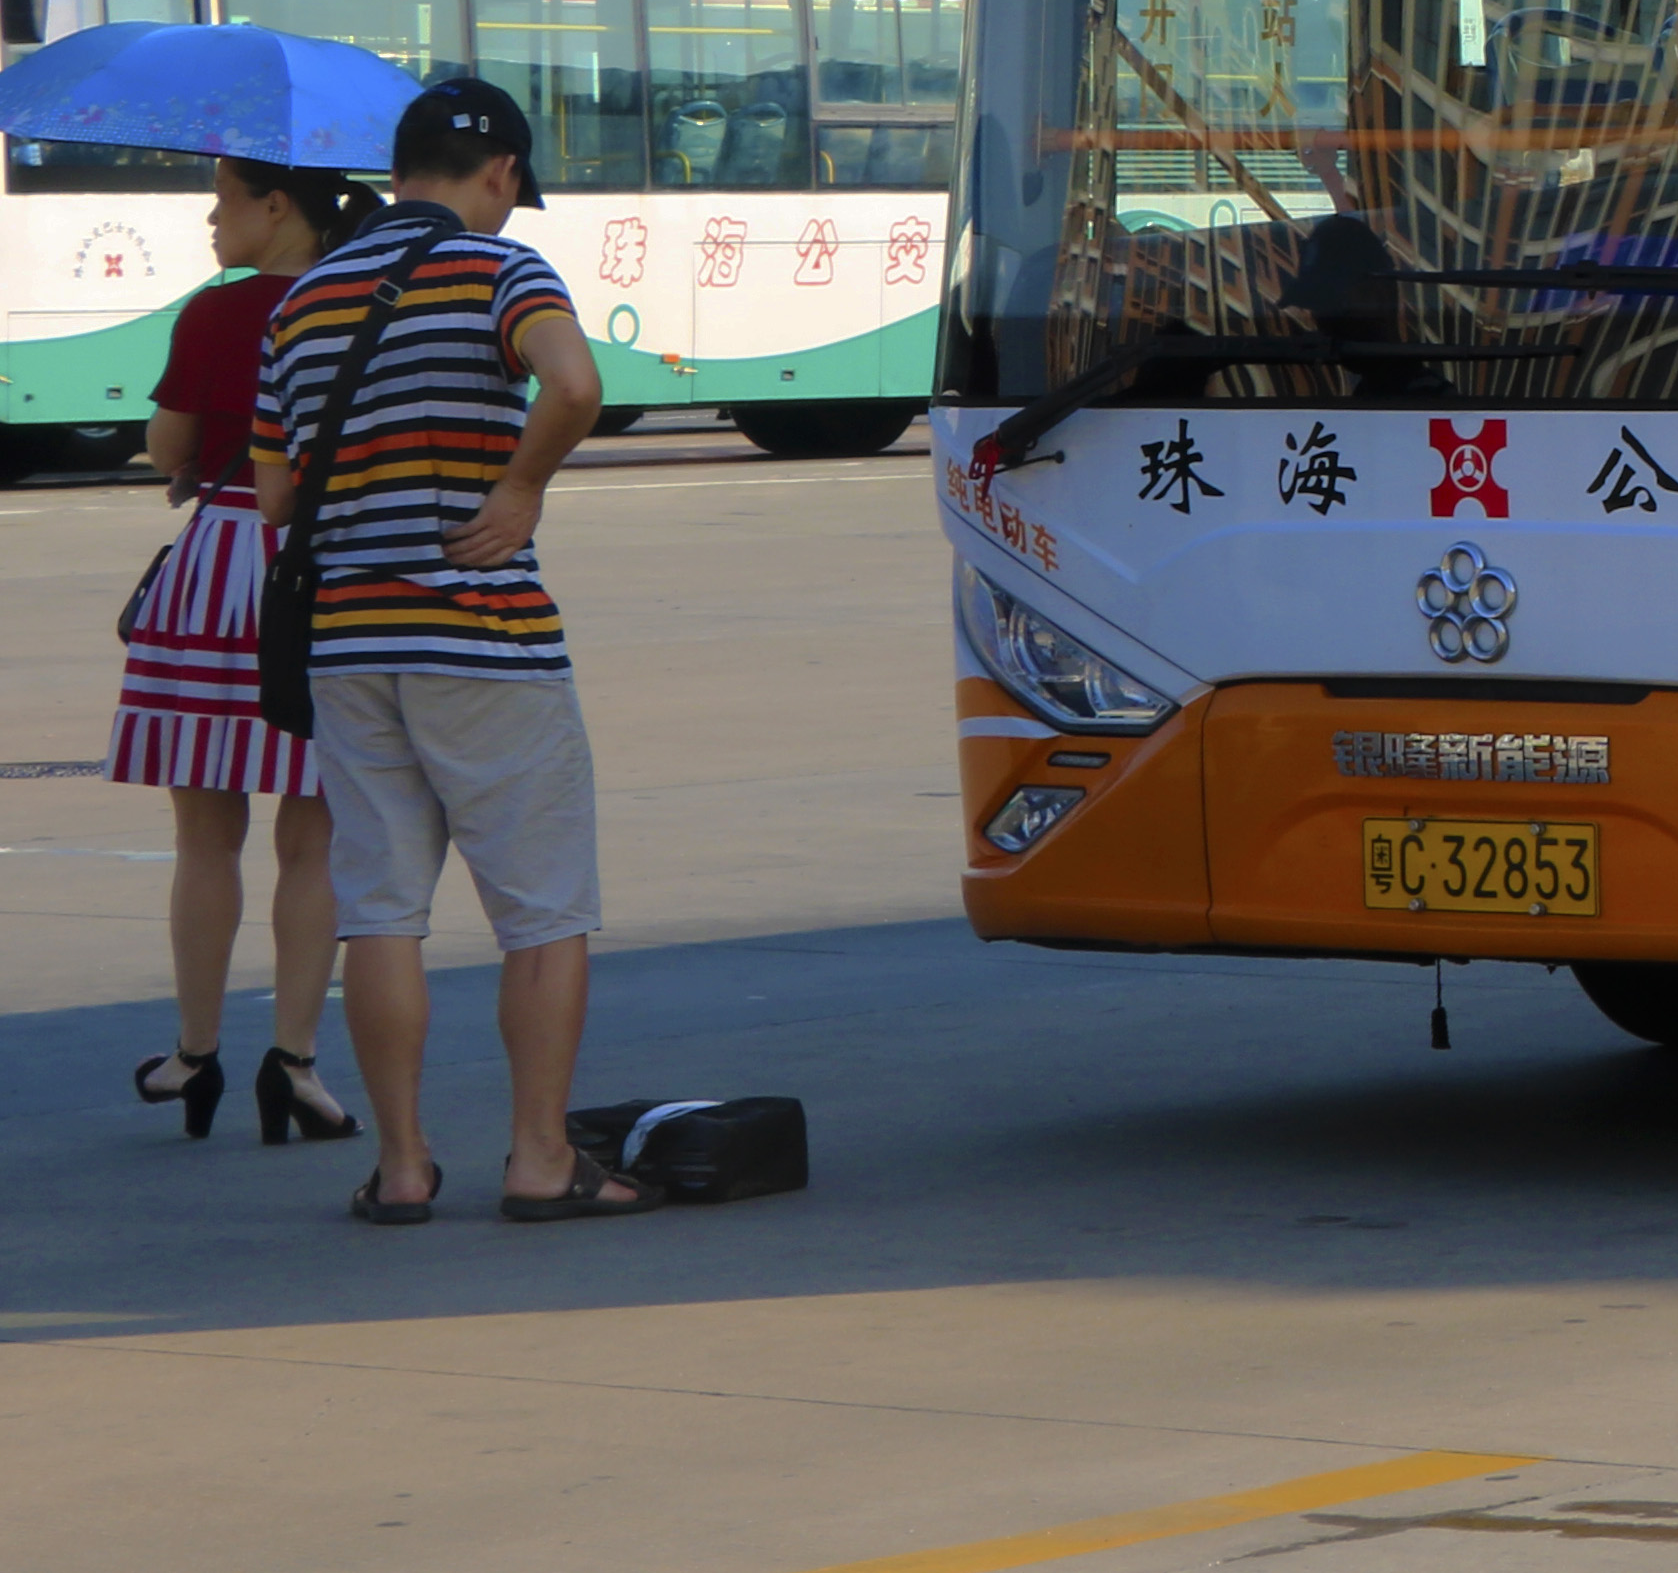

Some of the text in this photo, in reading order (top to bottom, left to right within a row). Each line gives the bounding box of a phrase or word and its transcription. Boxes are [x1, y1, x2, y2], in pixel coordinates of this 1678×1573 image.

[599, 216, 932, 288] 珠海公交
[947, 457, 1060, 573] 纯电动车
[1332, 730, 1611, 784] 银隆新能源
